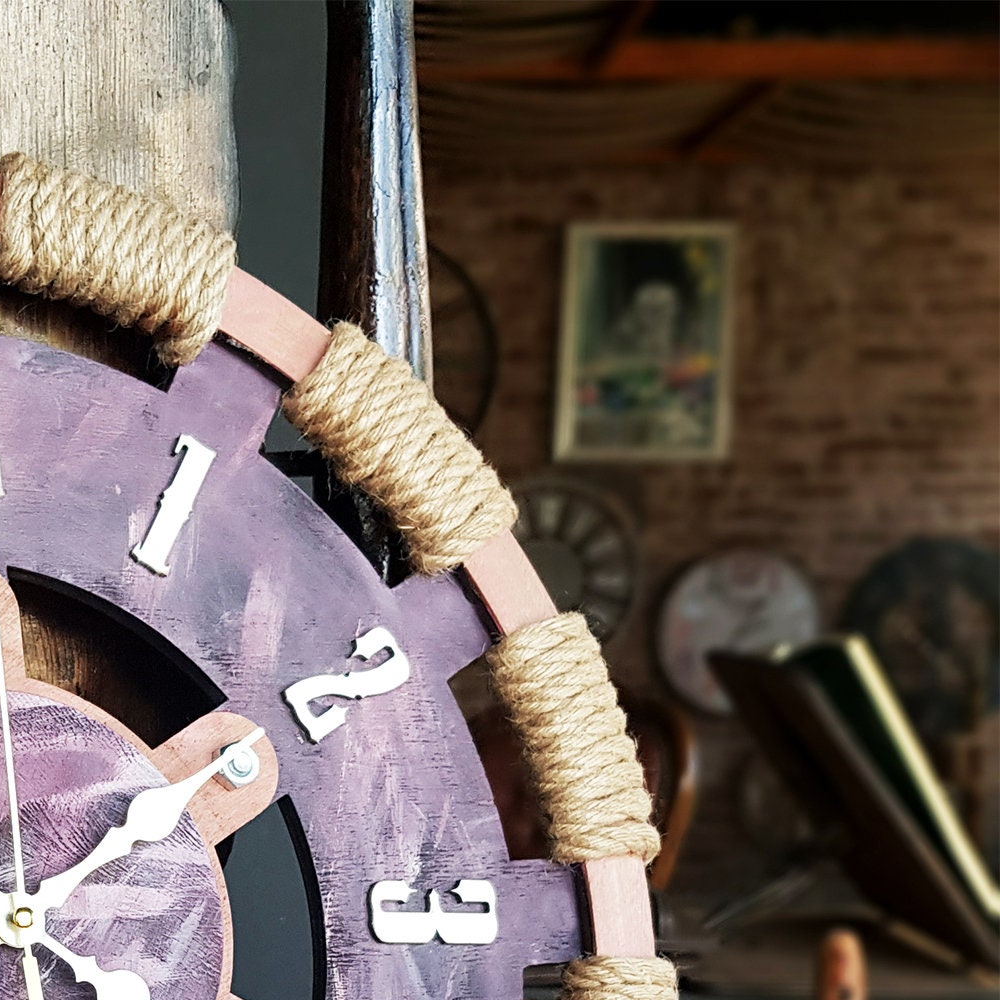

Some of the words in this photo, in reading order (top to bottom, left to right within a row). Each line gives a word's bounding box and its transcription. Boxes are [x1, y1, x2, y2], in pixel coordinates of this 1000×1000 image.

[132, 433, 217, 576] 1
[283, 626, 410, 744] 2
[368, 878, 497, 945] 3
